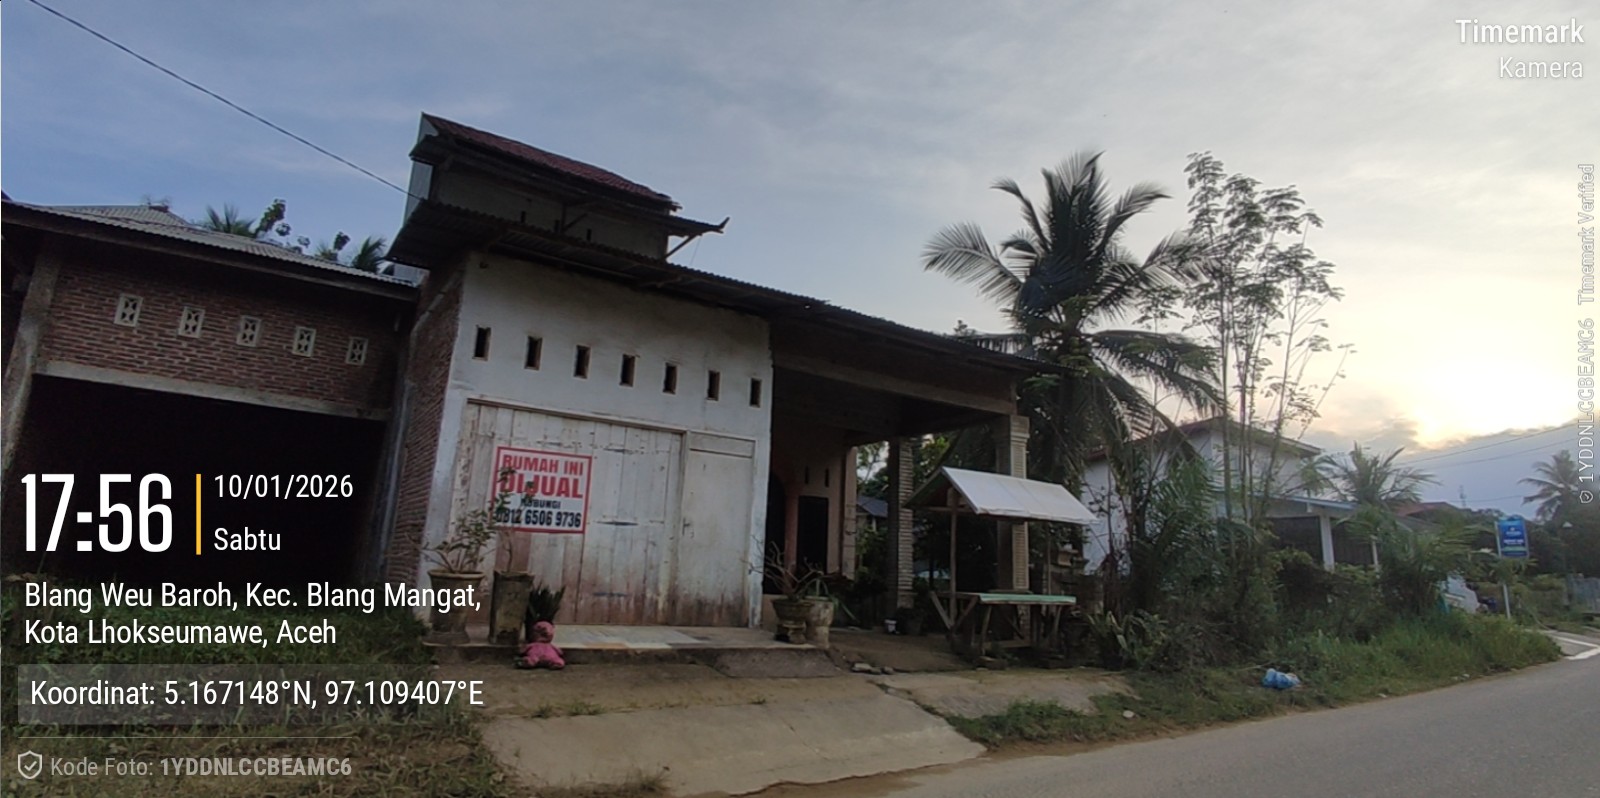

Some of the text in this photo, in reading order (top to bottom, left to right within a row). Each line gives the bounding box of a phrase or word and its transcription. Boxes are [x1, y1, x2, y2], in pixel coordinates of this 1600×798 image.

[503, 454, 584, 475] RUMAH INI
[499, 473, 583, 498] DIJUAL
[525, 510, 553, 526] 6506
[556, 511, 581, 527] 9736
